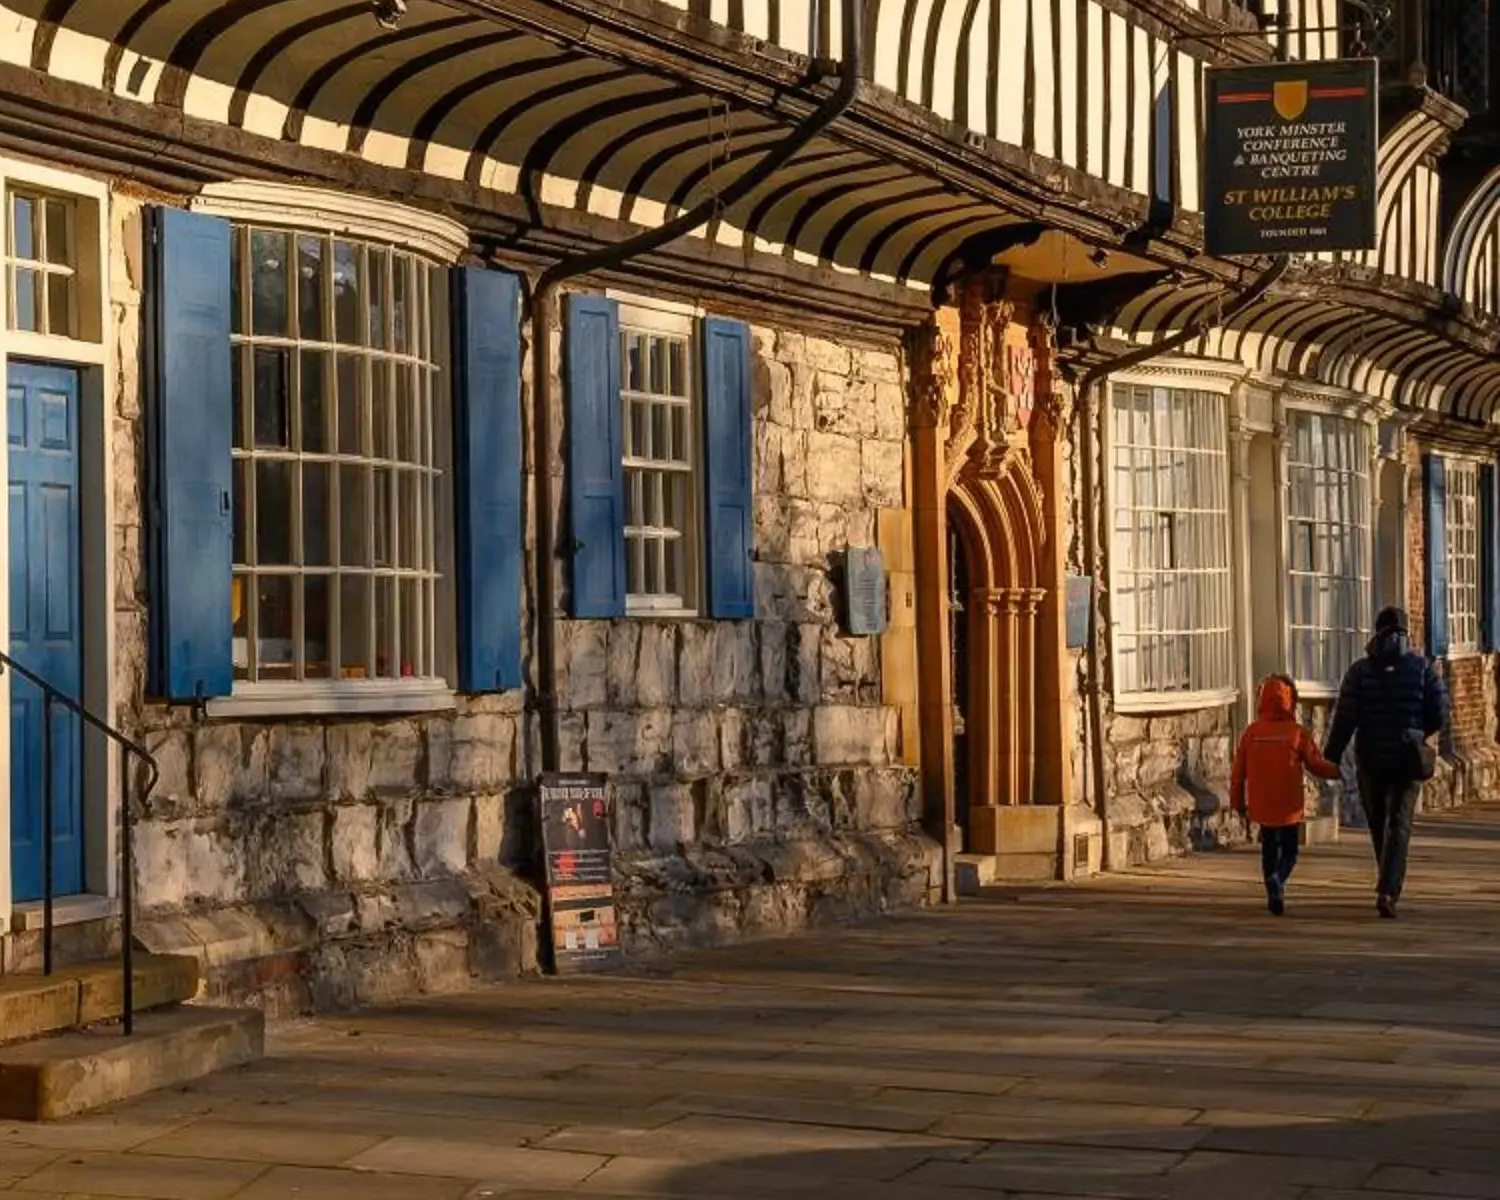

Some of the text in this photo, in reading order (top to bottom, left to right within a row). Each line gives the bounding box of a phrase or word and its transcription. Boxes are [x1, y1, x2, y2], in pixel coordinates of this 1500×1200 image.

[1237, 121, 1346, 138] YORK MINSTER
[1243, 136, 1339, 152] CONFERENCE
[1233, 149, 1347, 166] & BANQUETING
[1261, 164, 1319, 178] CENTRE
[1223, 185, 1356, 205] ST WILLIAM'S
[1248, 203, 1330, 220] COLLEGE
